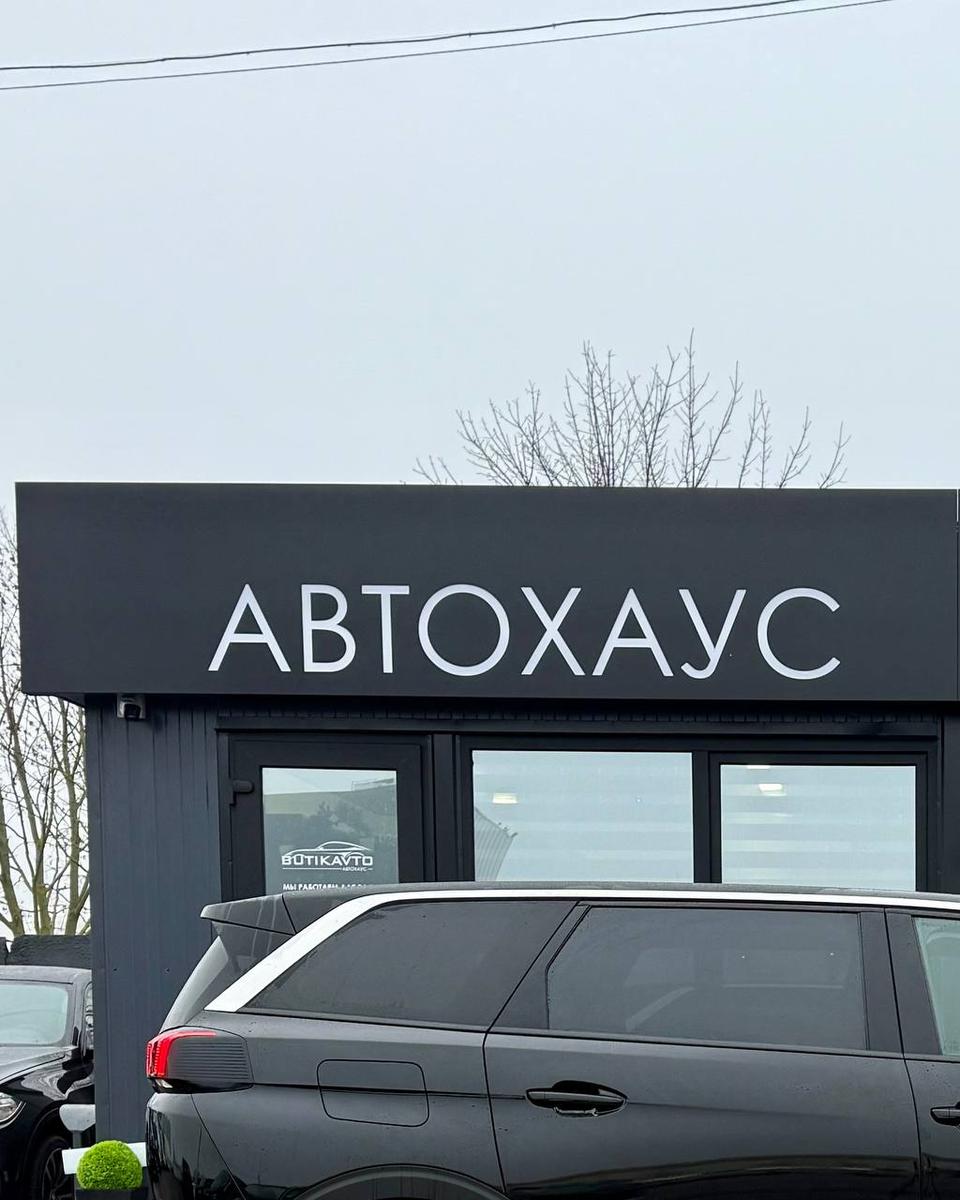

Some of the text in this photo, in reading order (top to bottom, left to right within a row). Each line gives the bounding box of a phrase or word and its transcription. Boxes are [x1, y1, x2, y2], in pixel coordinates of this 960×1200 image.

[208, 583, 841, 680] АВТОХАУС
[281, 855, 374, 866] BUTIKAVTO
[283, 883, 297, 891] МЫ
